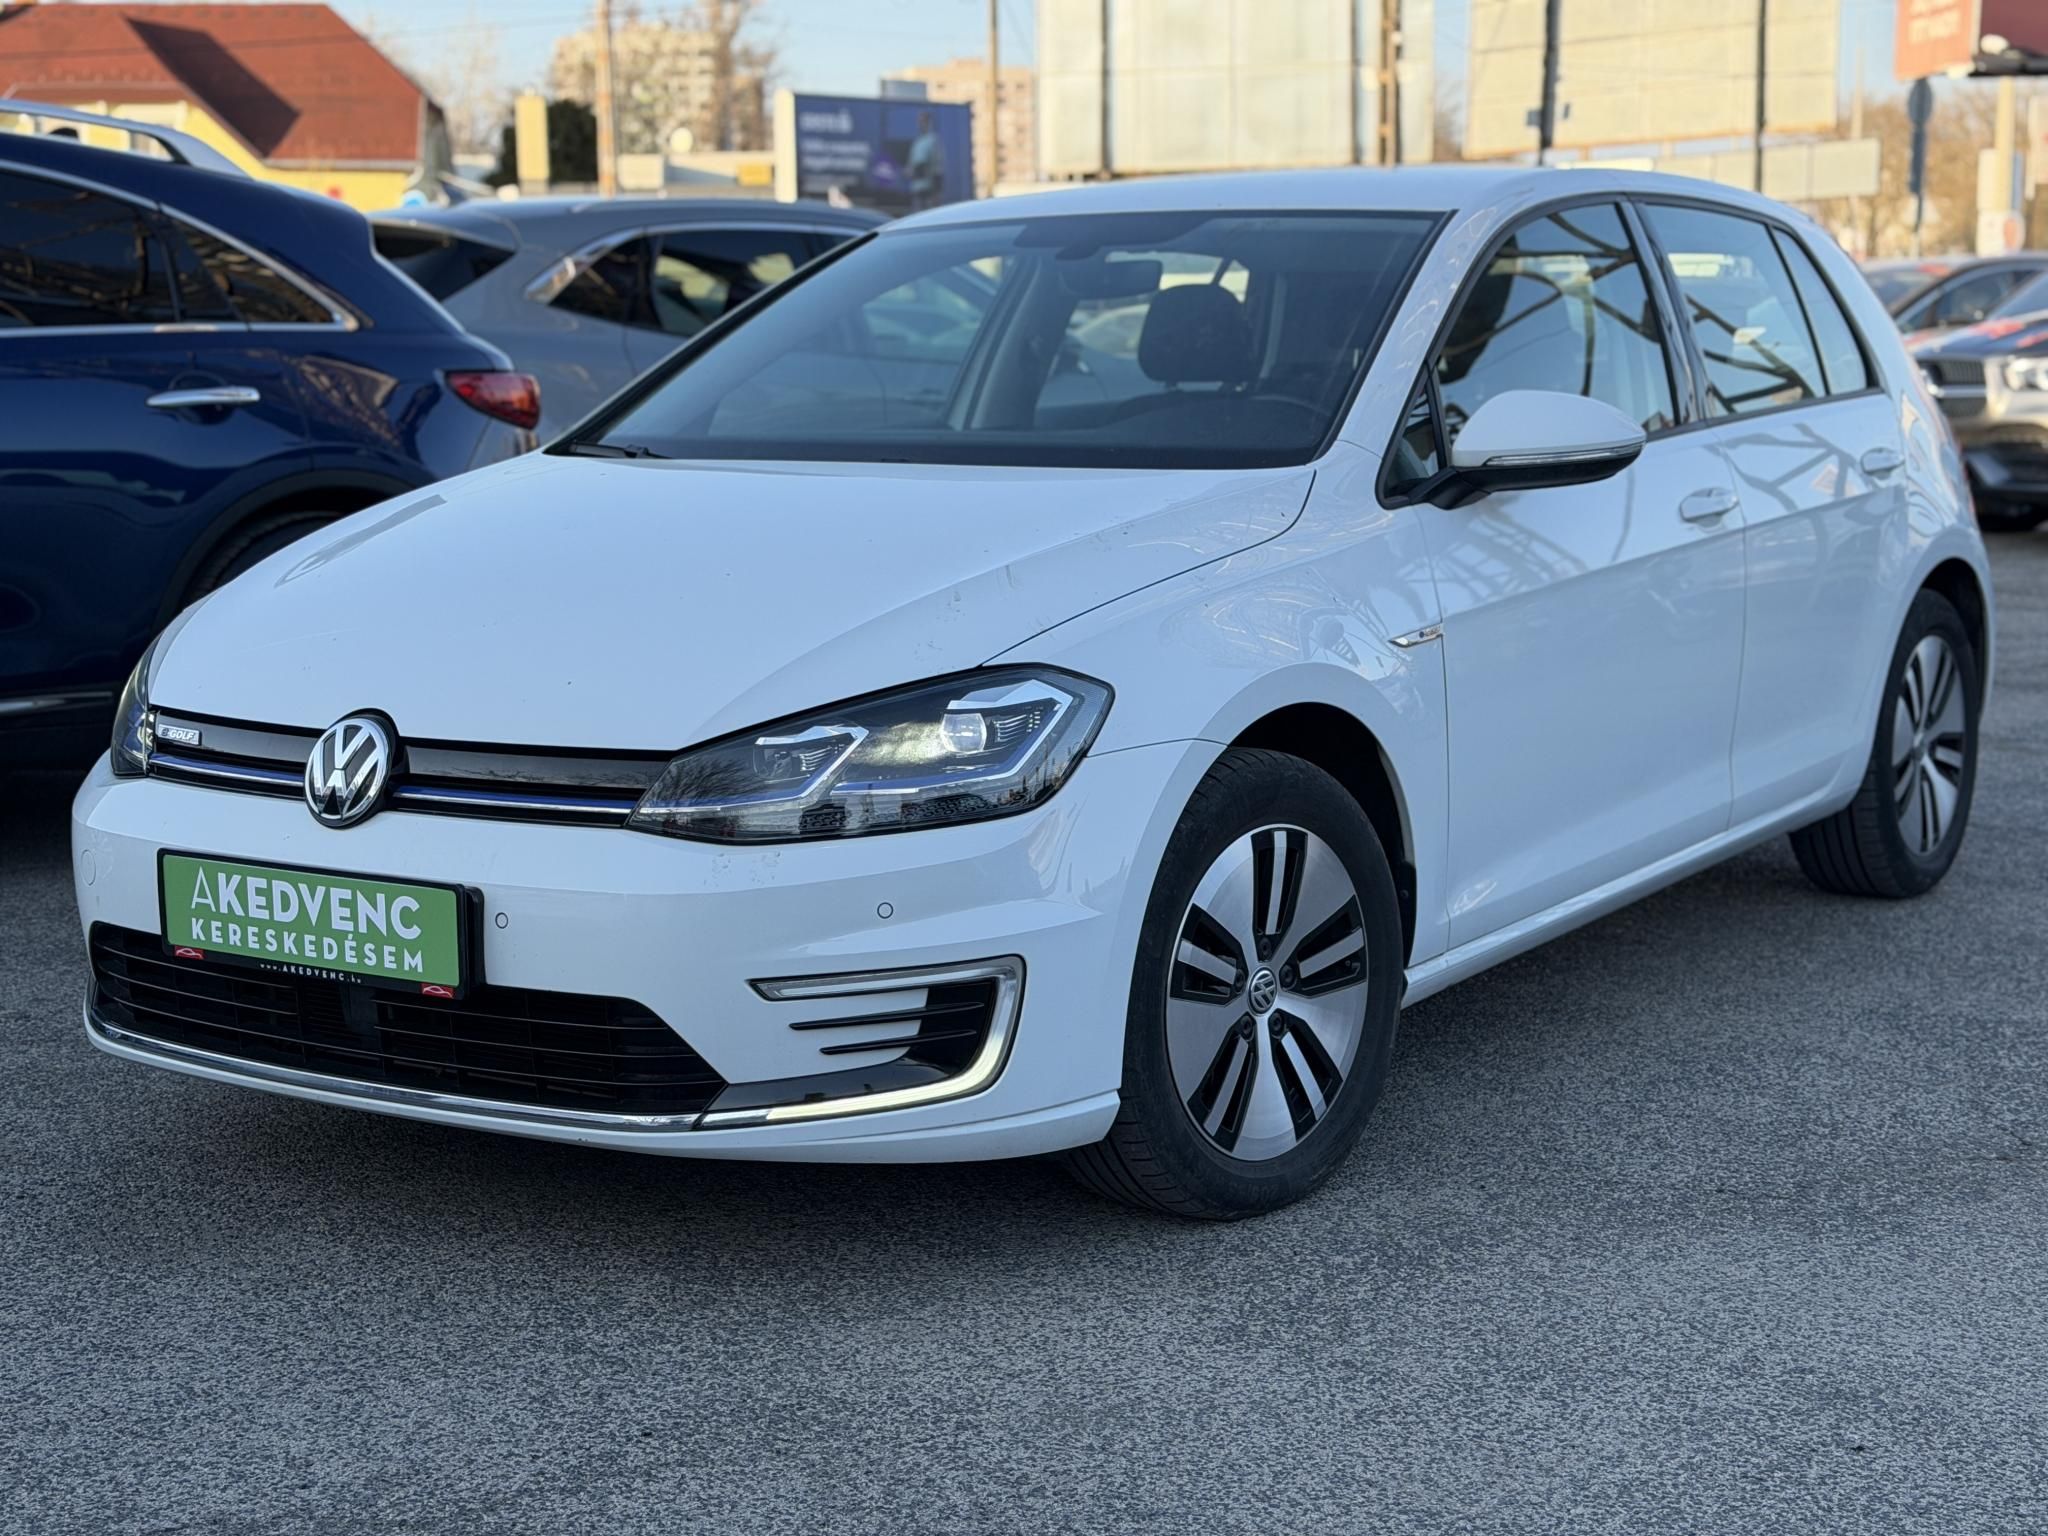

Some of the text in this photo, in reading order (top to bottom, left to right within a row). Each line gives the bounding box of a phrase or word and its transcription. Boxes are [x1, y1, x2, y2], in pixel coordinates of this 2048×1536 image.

[191, 866, 422, 940] AKEDVENC
[191, 917, 424, 973] KERESKEDÉSEM
[260, 963, 362, 984] www.AKEDVENC.hu
